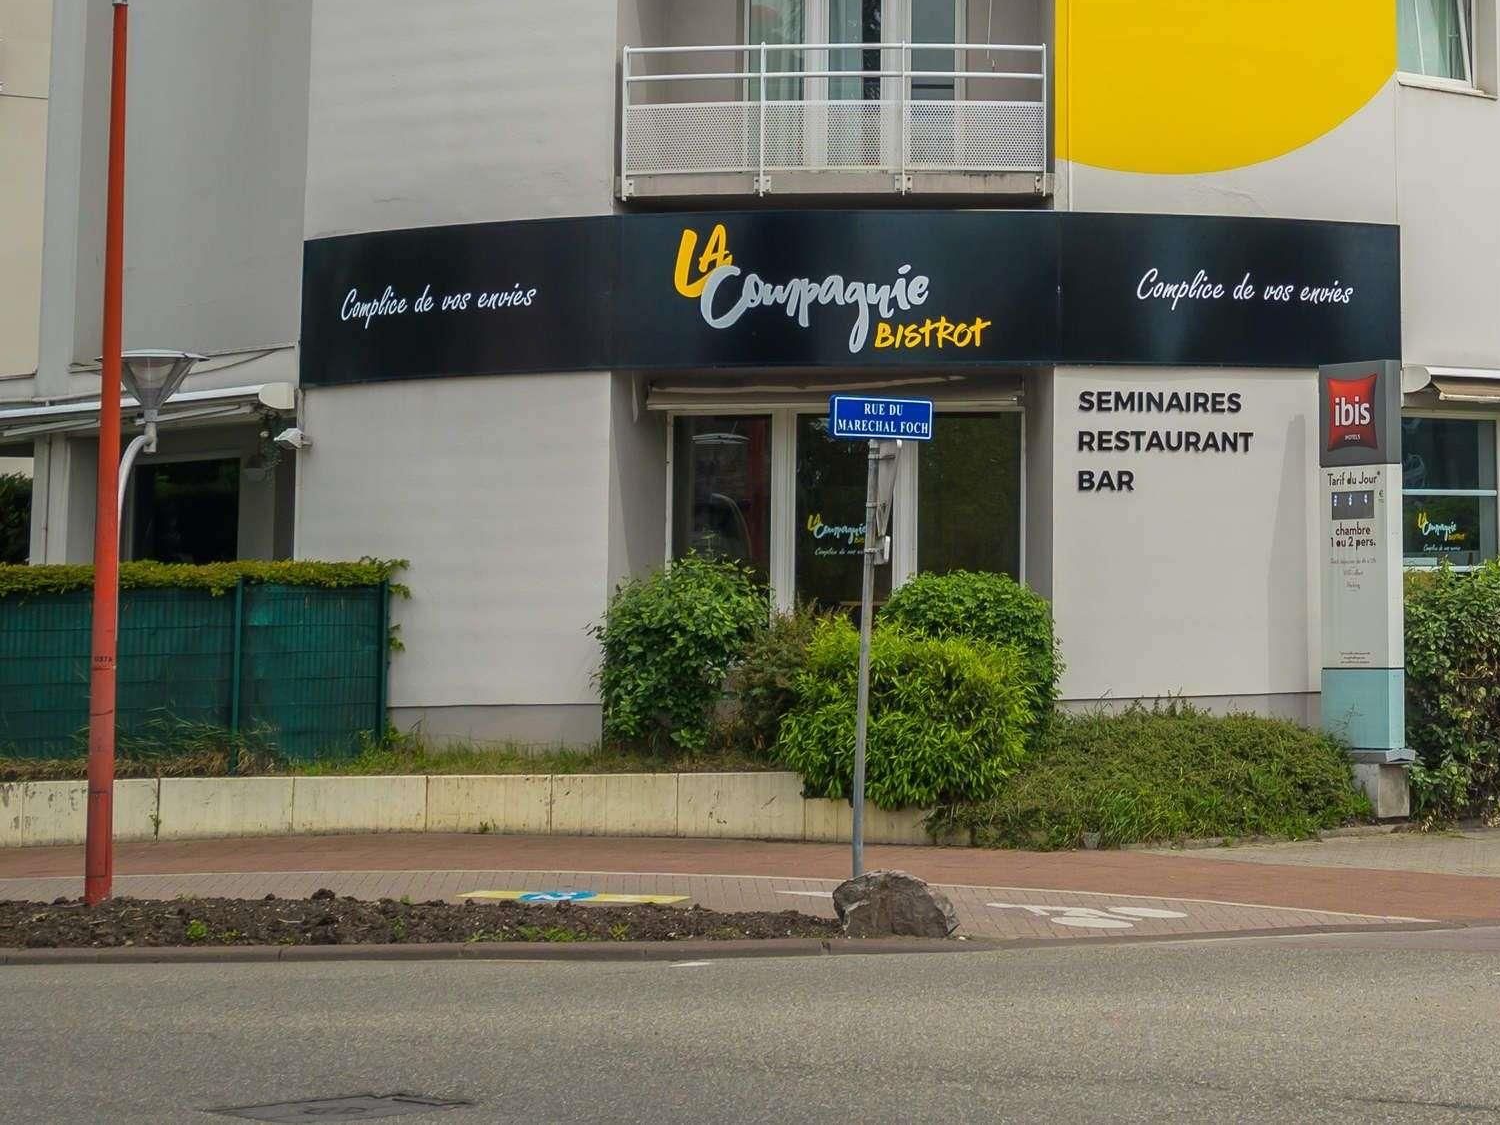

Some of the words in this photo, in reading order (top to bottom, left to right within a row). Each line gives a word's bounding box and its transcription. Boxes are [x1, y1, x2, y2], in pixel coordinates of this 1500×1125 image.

[1136, 267, 1225, 311] Complice
[1233, 272, 1255, 300] de
[1263, 283, 1293, 303] vos
[1300, 280, 1354, 304] envies
[341, 285, 408, 329] Complice
[414, 284, 434, 312] de
[442, 292, 471, 310] vos
[477, 283, 537, 310] envies
[700, 264, 930, 354] Compagnie
[864, 403, 885, 415] RUE
[889, 404, 904, 416] DU
[1078, 390, 1243, 413] SEMINAIRES
[1334, 396, 1371, 426] ibis
[838, 419, 896, 433] MARECHAL
[900, 422, 928, 434] FOCH
[1077, 430, 1254, 453] RESTAURANT
[1077, 470, 1135, 492] BAR
[1327, 471, 1345, 486] Tarif
[1347, 470, 1357, 484] du
[1335, 522, 1371, 536] chambre
[1336, 539, 1346, 548] ou
